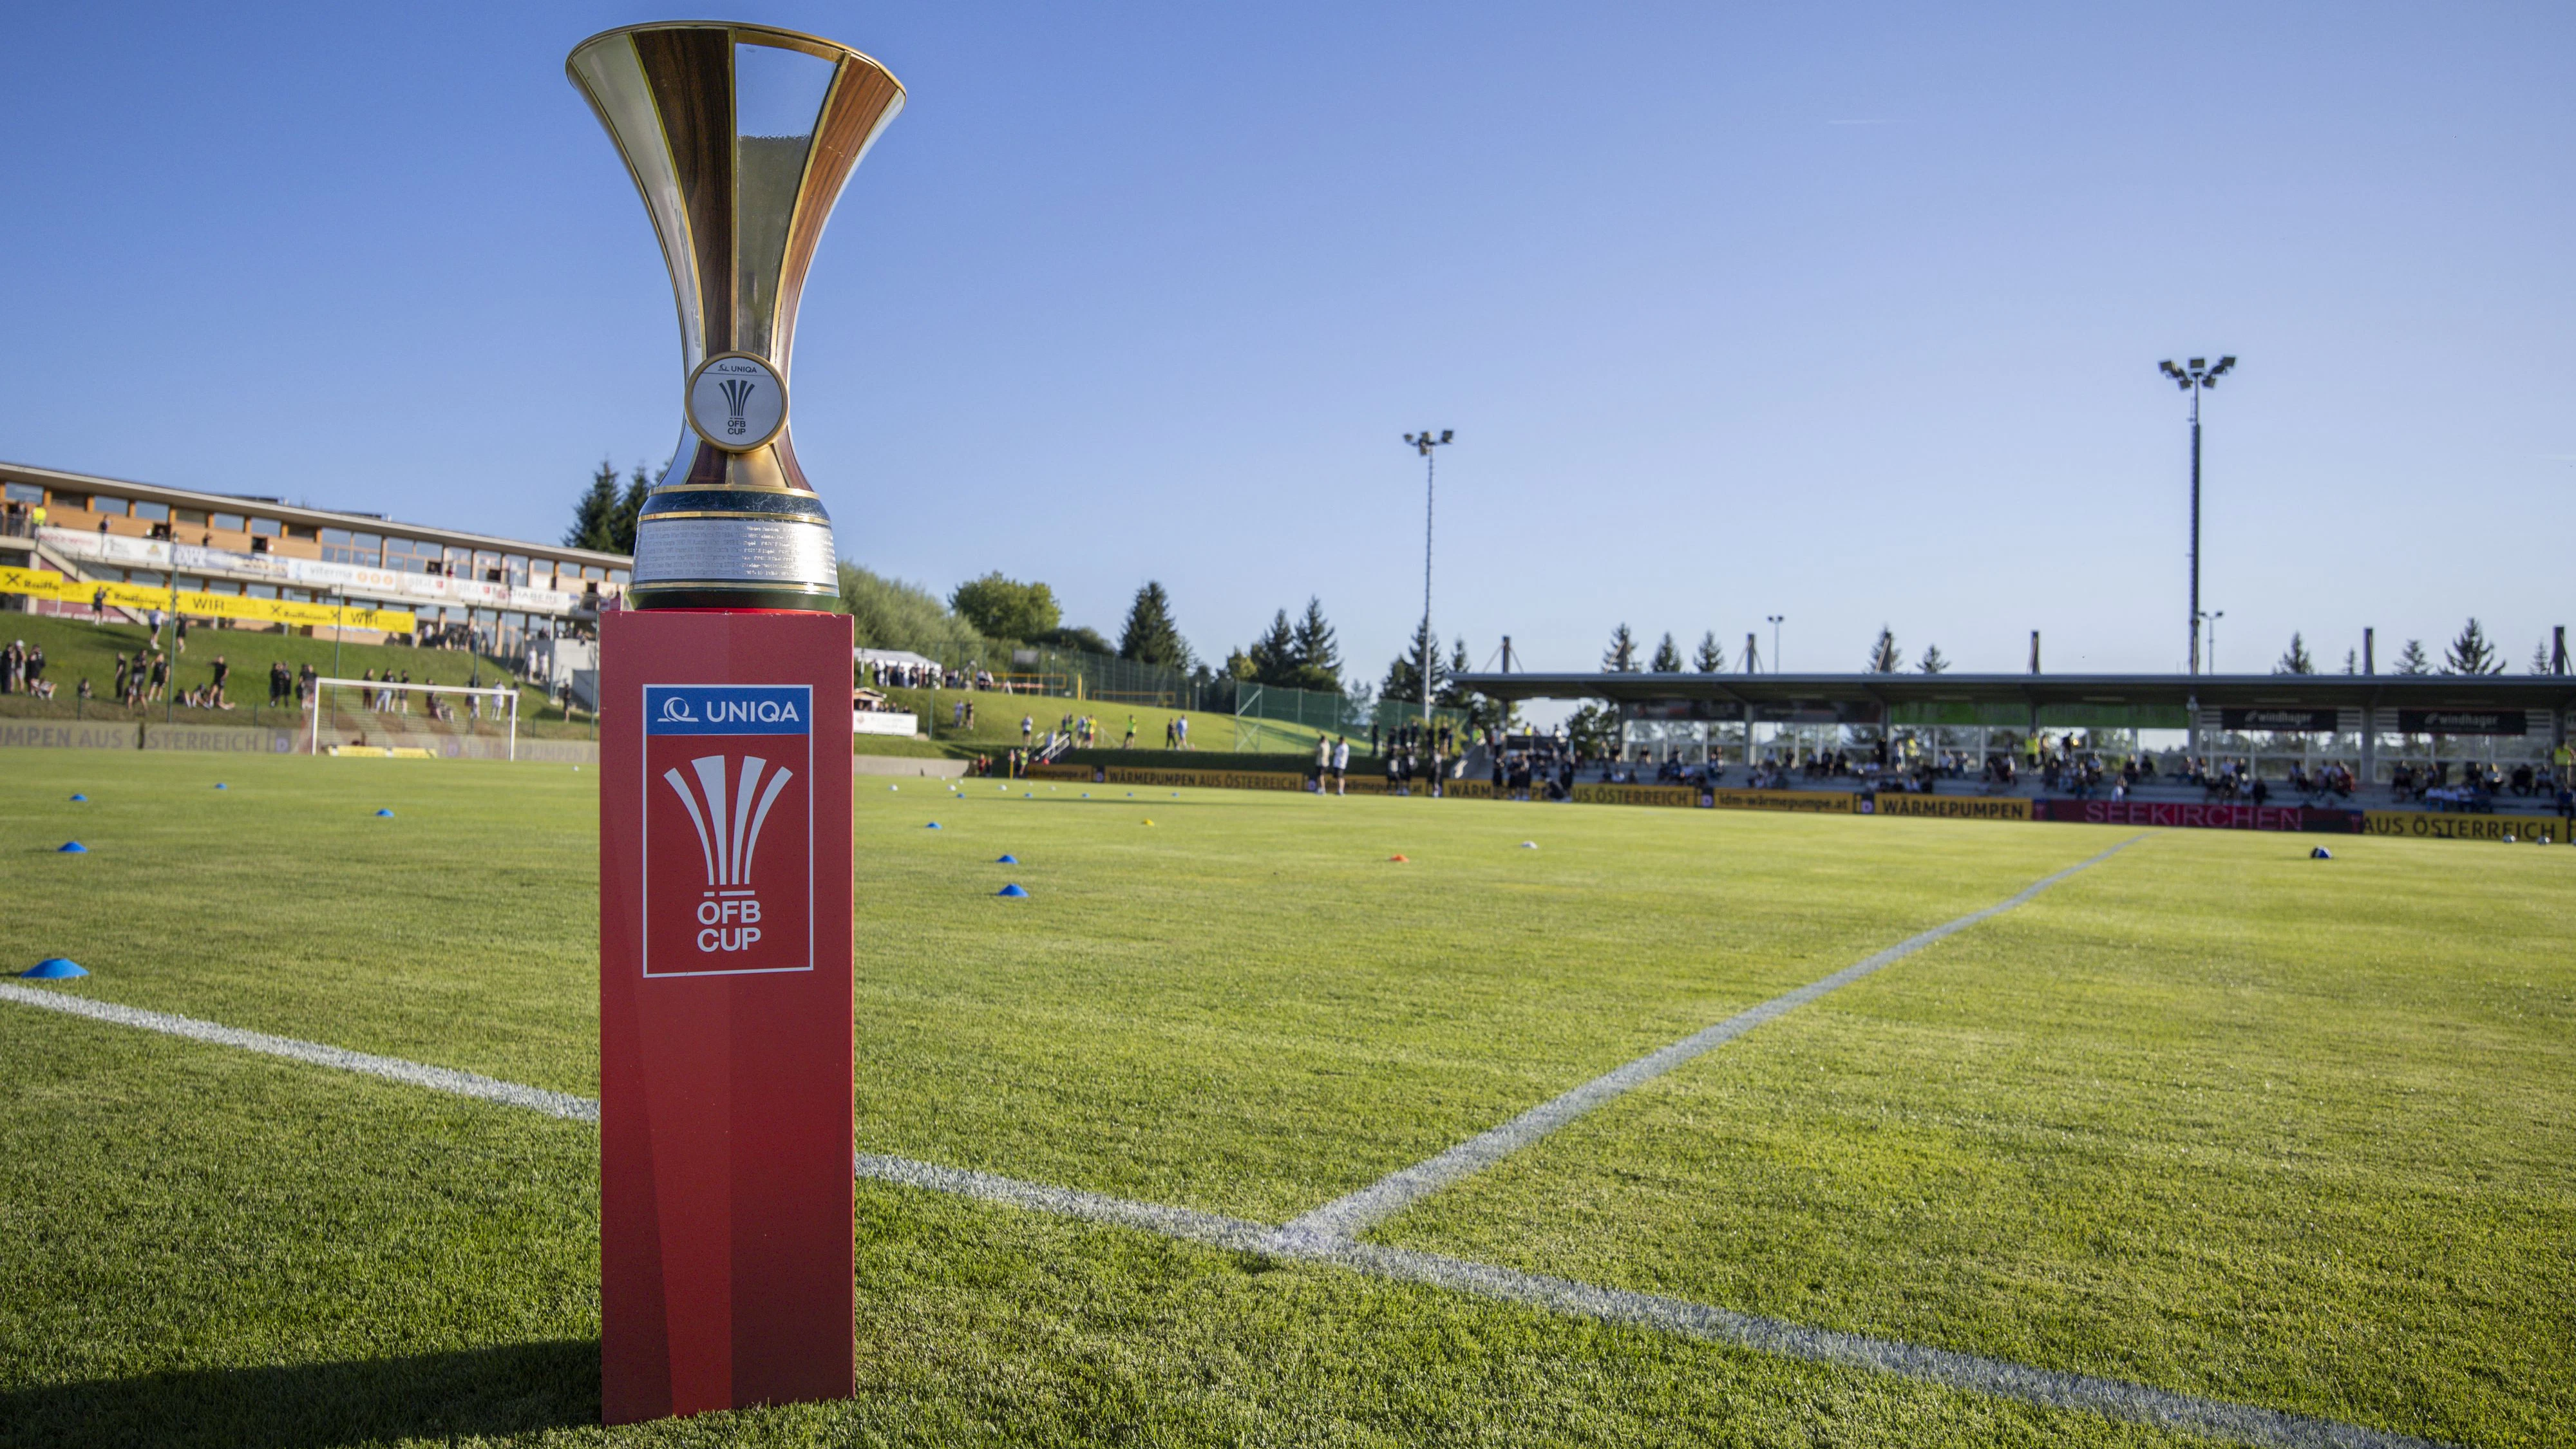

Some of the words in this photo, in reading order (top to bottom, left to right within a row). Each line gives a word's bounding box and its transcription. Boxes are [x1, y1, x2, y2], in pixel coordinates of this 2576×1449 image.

[706, 701, 800, 723] UNIQA
[0, 726, 70, 748] MPEN
[78, 728, 122, 748] AUS
[1109, 771, 1196, 786] WÄRMEPUMPEN
[1199, 774, 1222, 788] AUS
[1226, 773, 1298, 791] ÖSTERREICH
[1595, 786, 1689, 806] ÖSTERREICH
[1882, 796, 2023, 818] WÄRMEPUMPEN
[2085, 802, 2303, 831] SEEKIRCHEN
[2362, 816, 2404, 835] AUS
[2412, 814, 2555, 840] ÖSTERREICH
[697, 927, 761, 952] CUP
